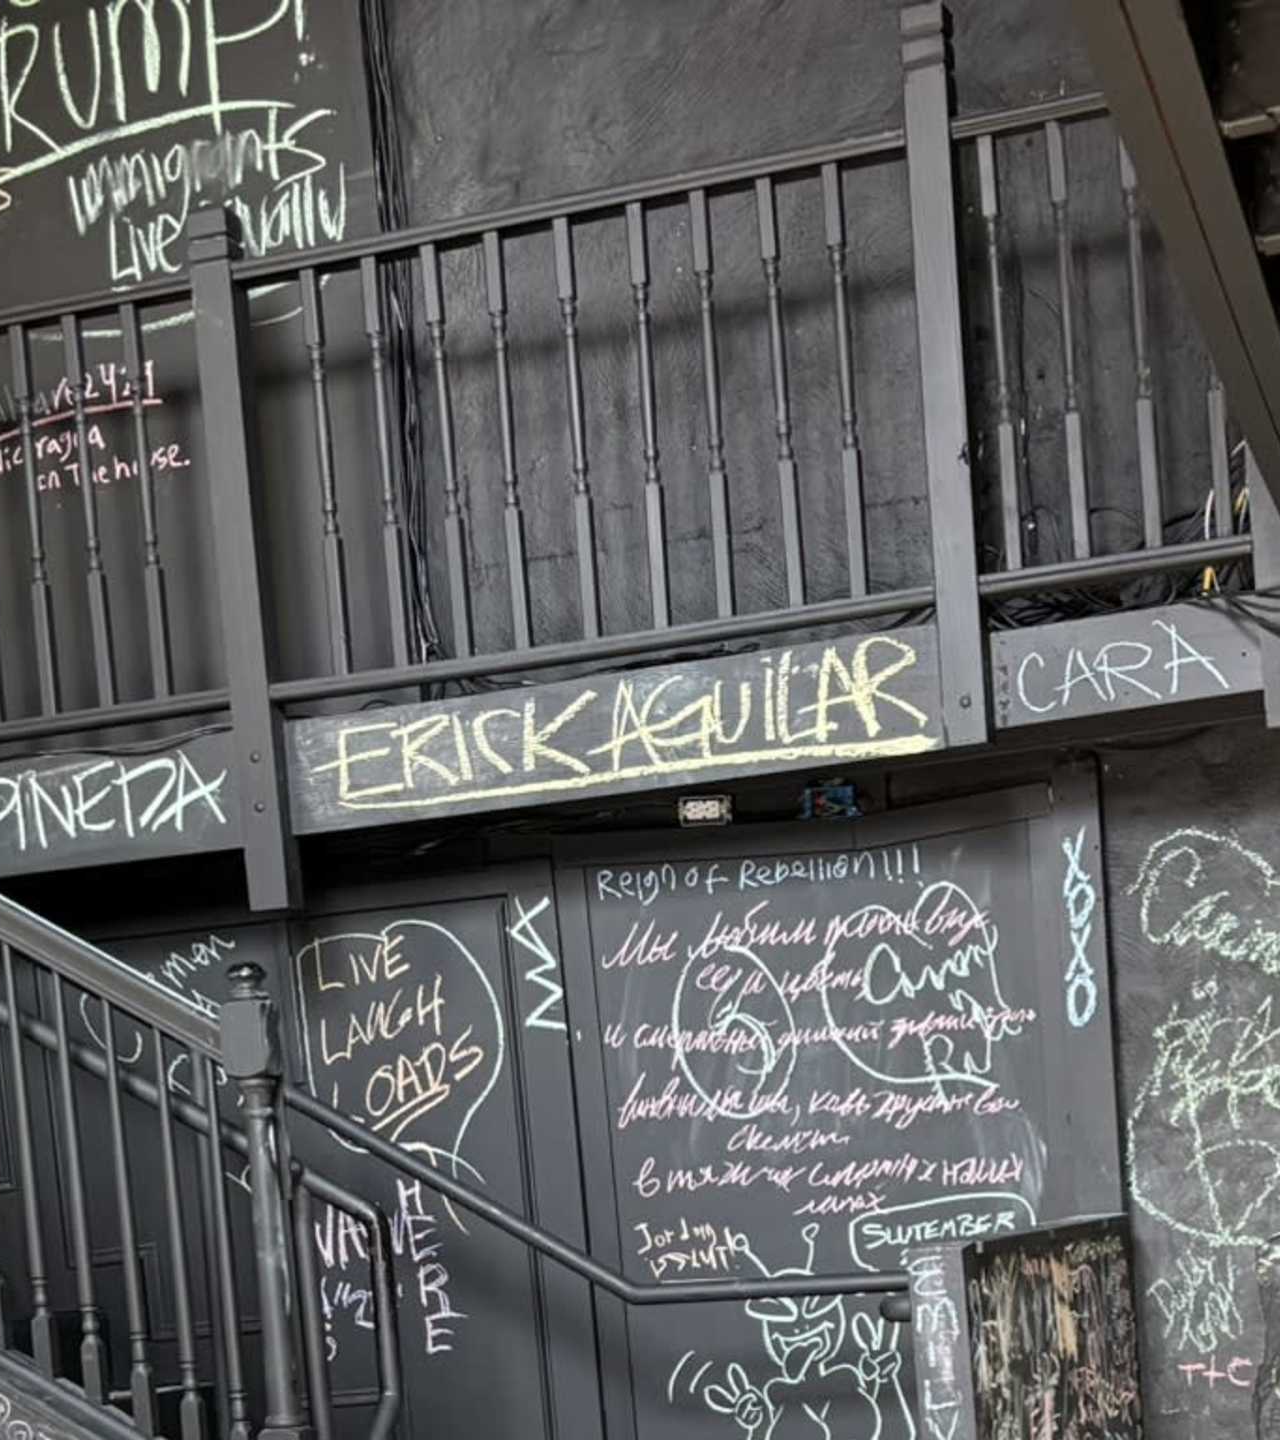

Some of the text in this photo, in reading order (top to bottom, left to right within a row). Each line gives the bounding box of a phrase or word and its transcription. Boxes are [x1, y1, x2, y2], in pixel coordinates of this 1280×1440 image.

[1018, 619, 1231, 712] CARA
[596, 862, 677, 907] Reign
[683, 864, 730, 895] of
[313, 932, 411, 991] LIVE
